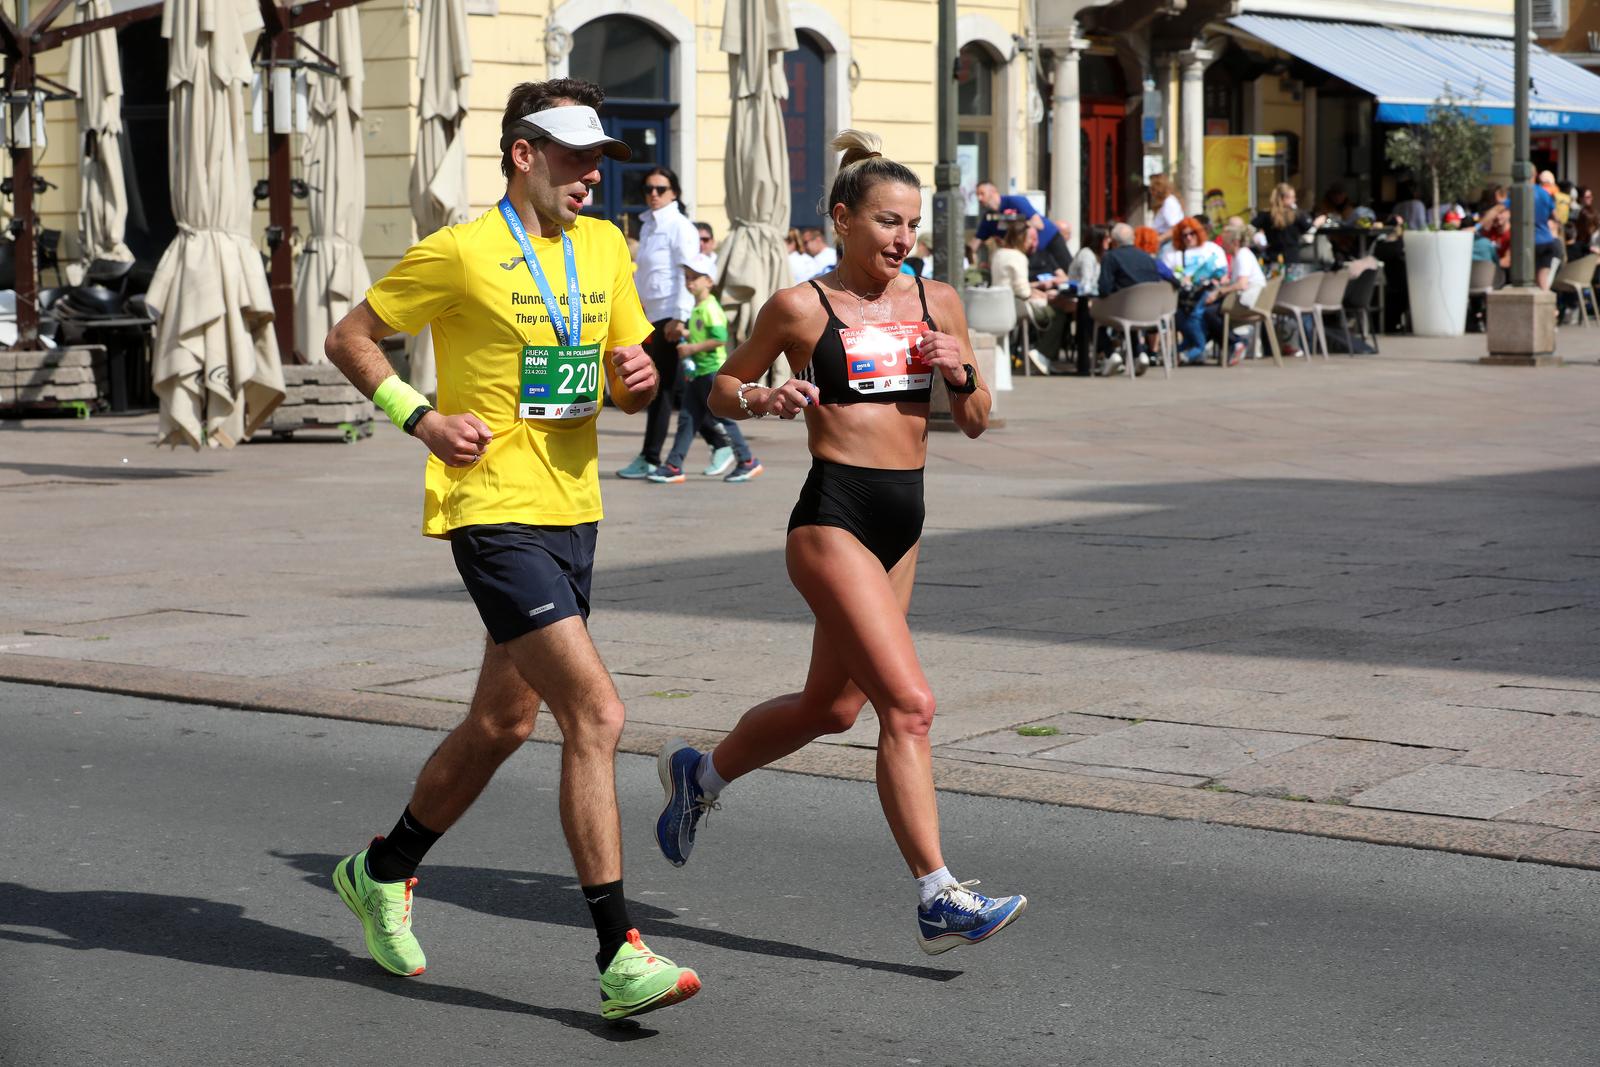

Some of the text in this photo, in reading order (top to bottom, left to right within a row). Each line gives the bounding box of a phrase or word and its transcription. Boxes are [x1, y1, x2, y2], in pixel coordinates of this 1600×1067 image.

[590, 291, 606, 304] die!
[515, 313, 538, 326] They
[582, 313, 597, 324] like
[597, 312, 603, 323] it
[525, 357, 548, 366] RUN
[558, 362, 597, 394] 220
[555, 407, 563, 415] A1
